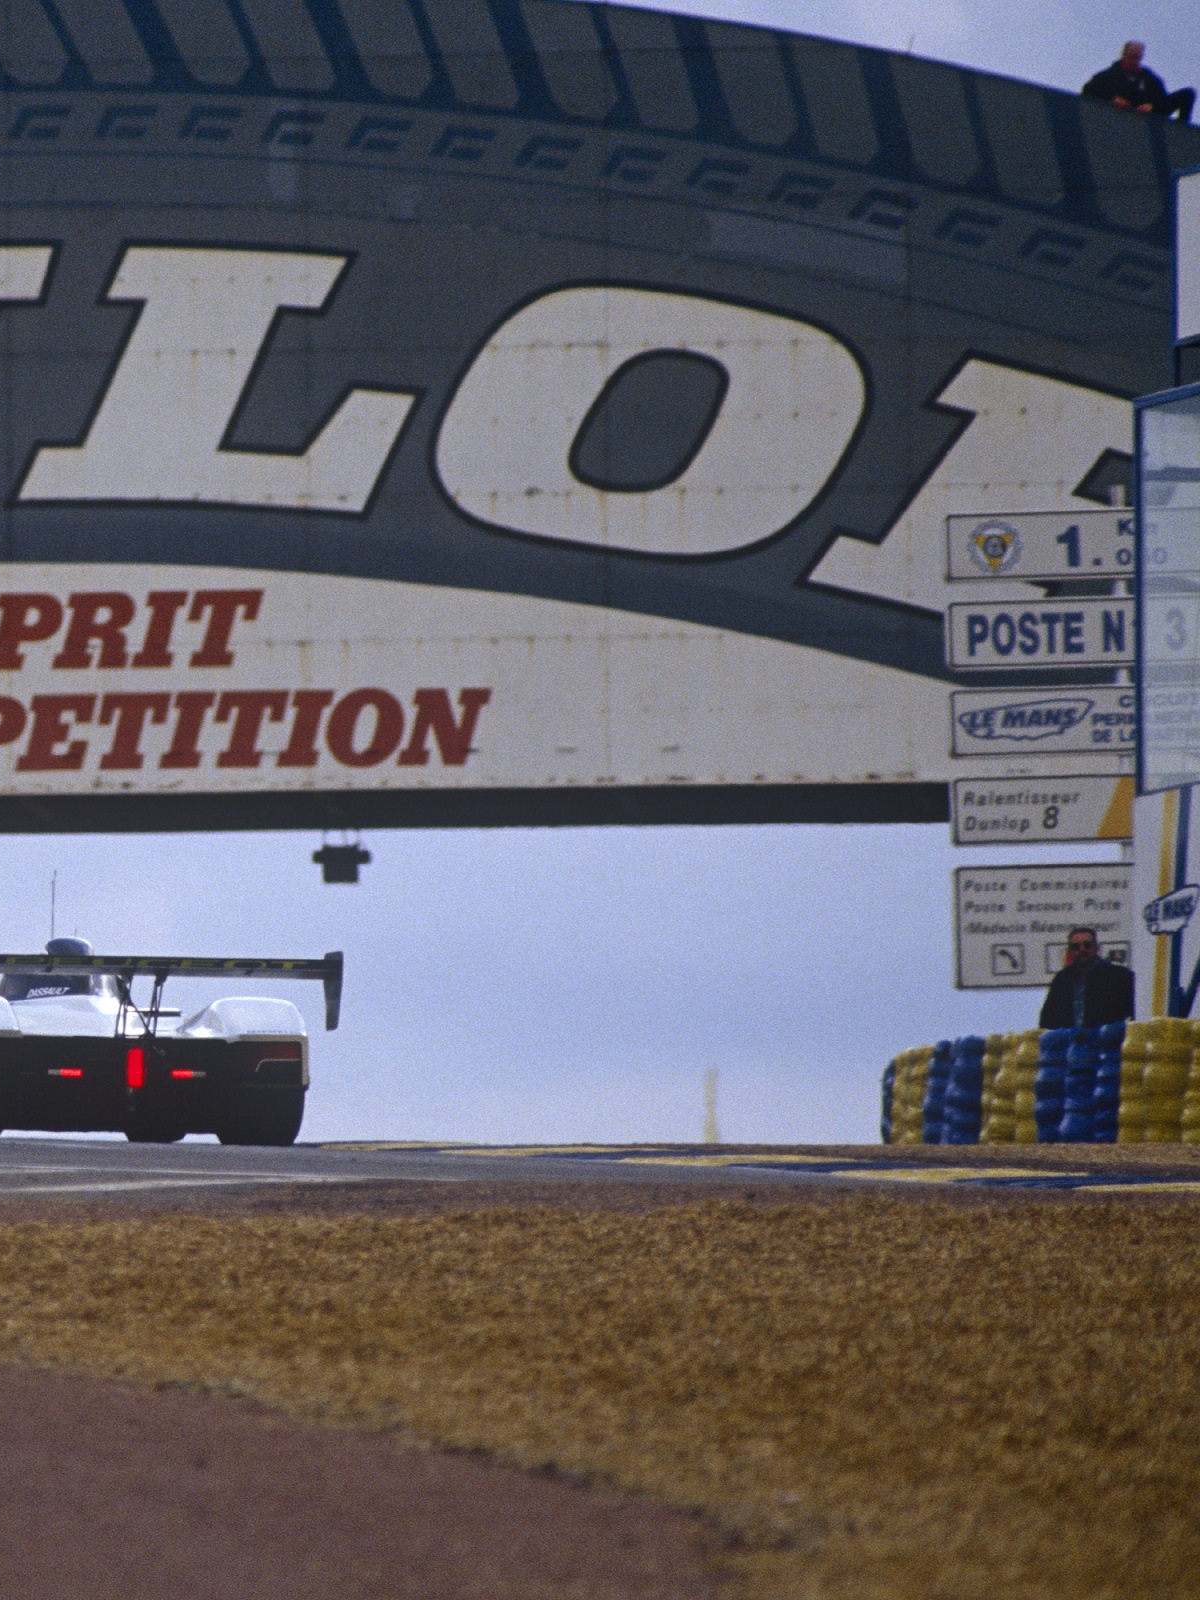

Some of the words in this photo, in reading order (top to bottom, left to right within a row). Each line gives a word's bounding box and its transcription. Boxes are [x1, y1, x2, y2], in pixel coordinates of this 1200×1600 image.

[967, 611, 1084, 656] POSTE
[1002, 708, 1077, 727] MANS
[1092, 729, 1111, 742] DE
[963, 790, 1081, 807] Ralentisseur
[964, 814, 1031, 833] Dunlop
[1042, 805, 1060, 830] 8
[963, 879, 1007, 892] Poste
[1019, 878, 1129, 892] Commissaires
[963, 900, 1005, 913] Poste
[1016, 900, 1074, 912] Secours
[1084, 898, 1121, 911] Piste
[26, 986, 72, 999] DASSAULT
